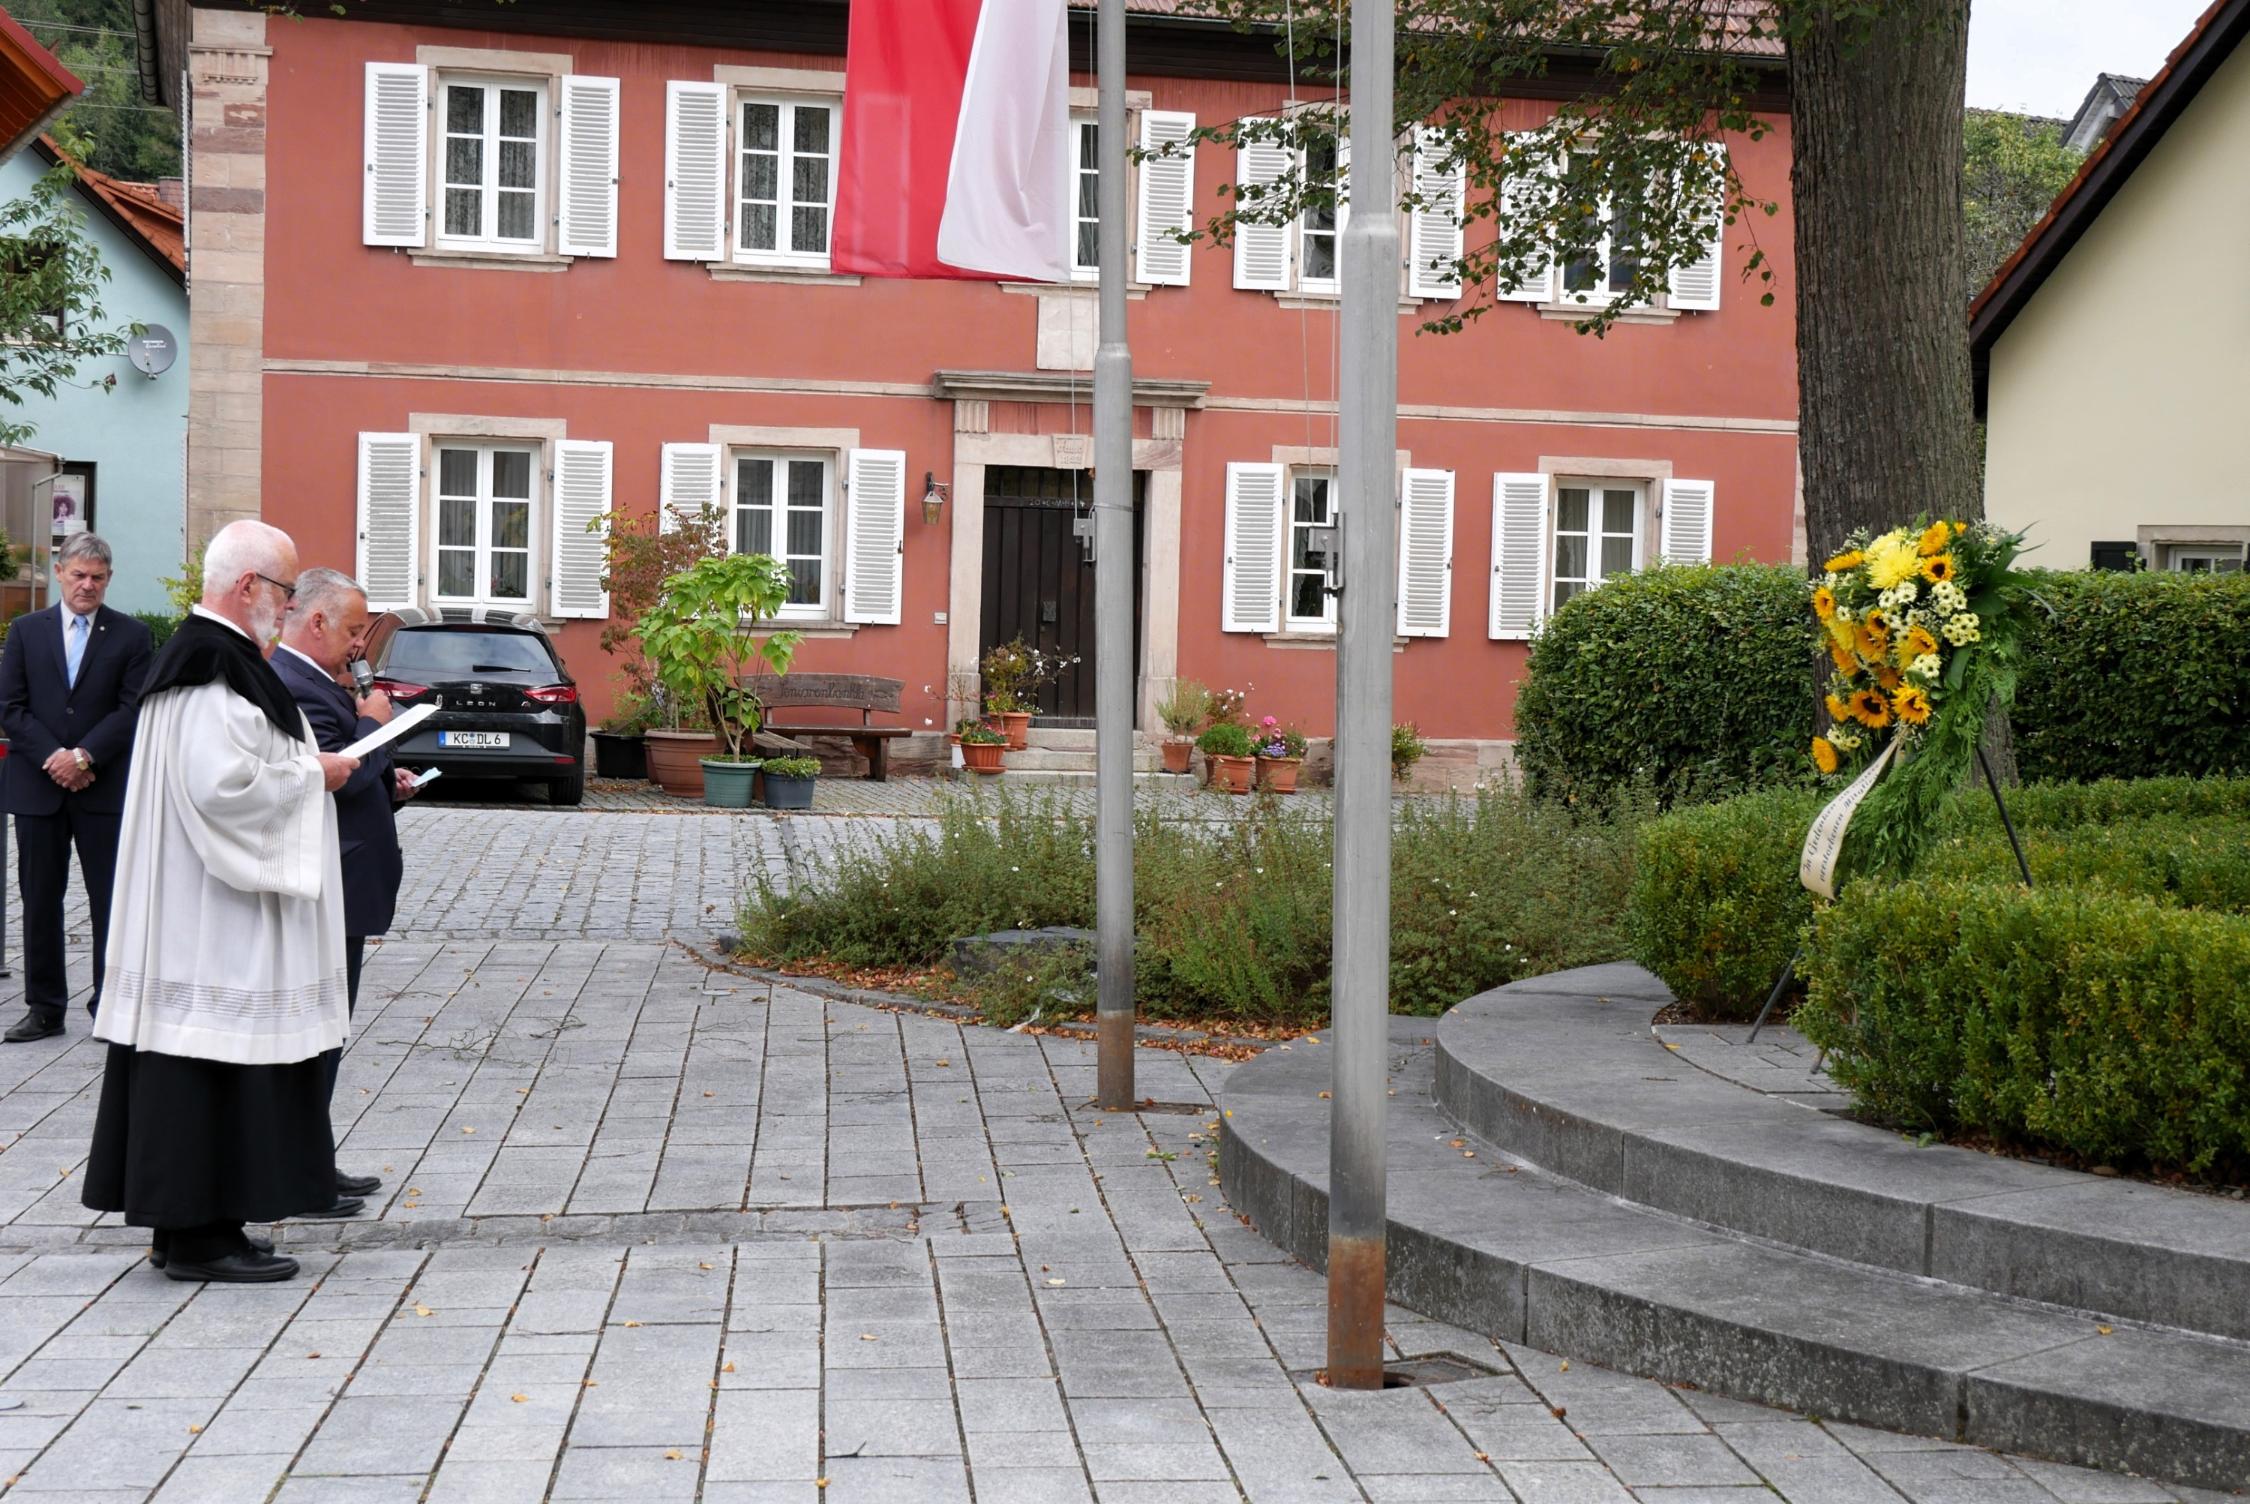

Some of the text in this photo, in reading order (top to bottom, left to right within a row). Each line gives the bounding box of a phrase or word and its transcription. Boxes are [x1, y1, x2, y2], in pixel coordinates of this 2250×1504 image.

[453, 733, 502, 745] KC DL 6
